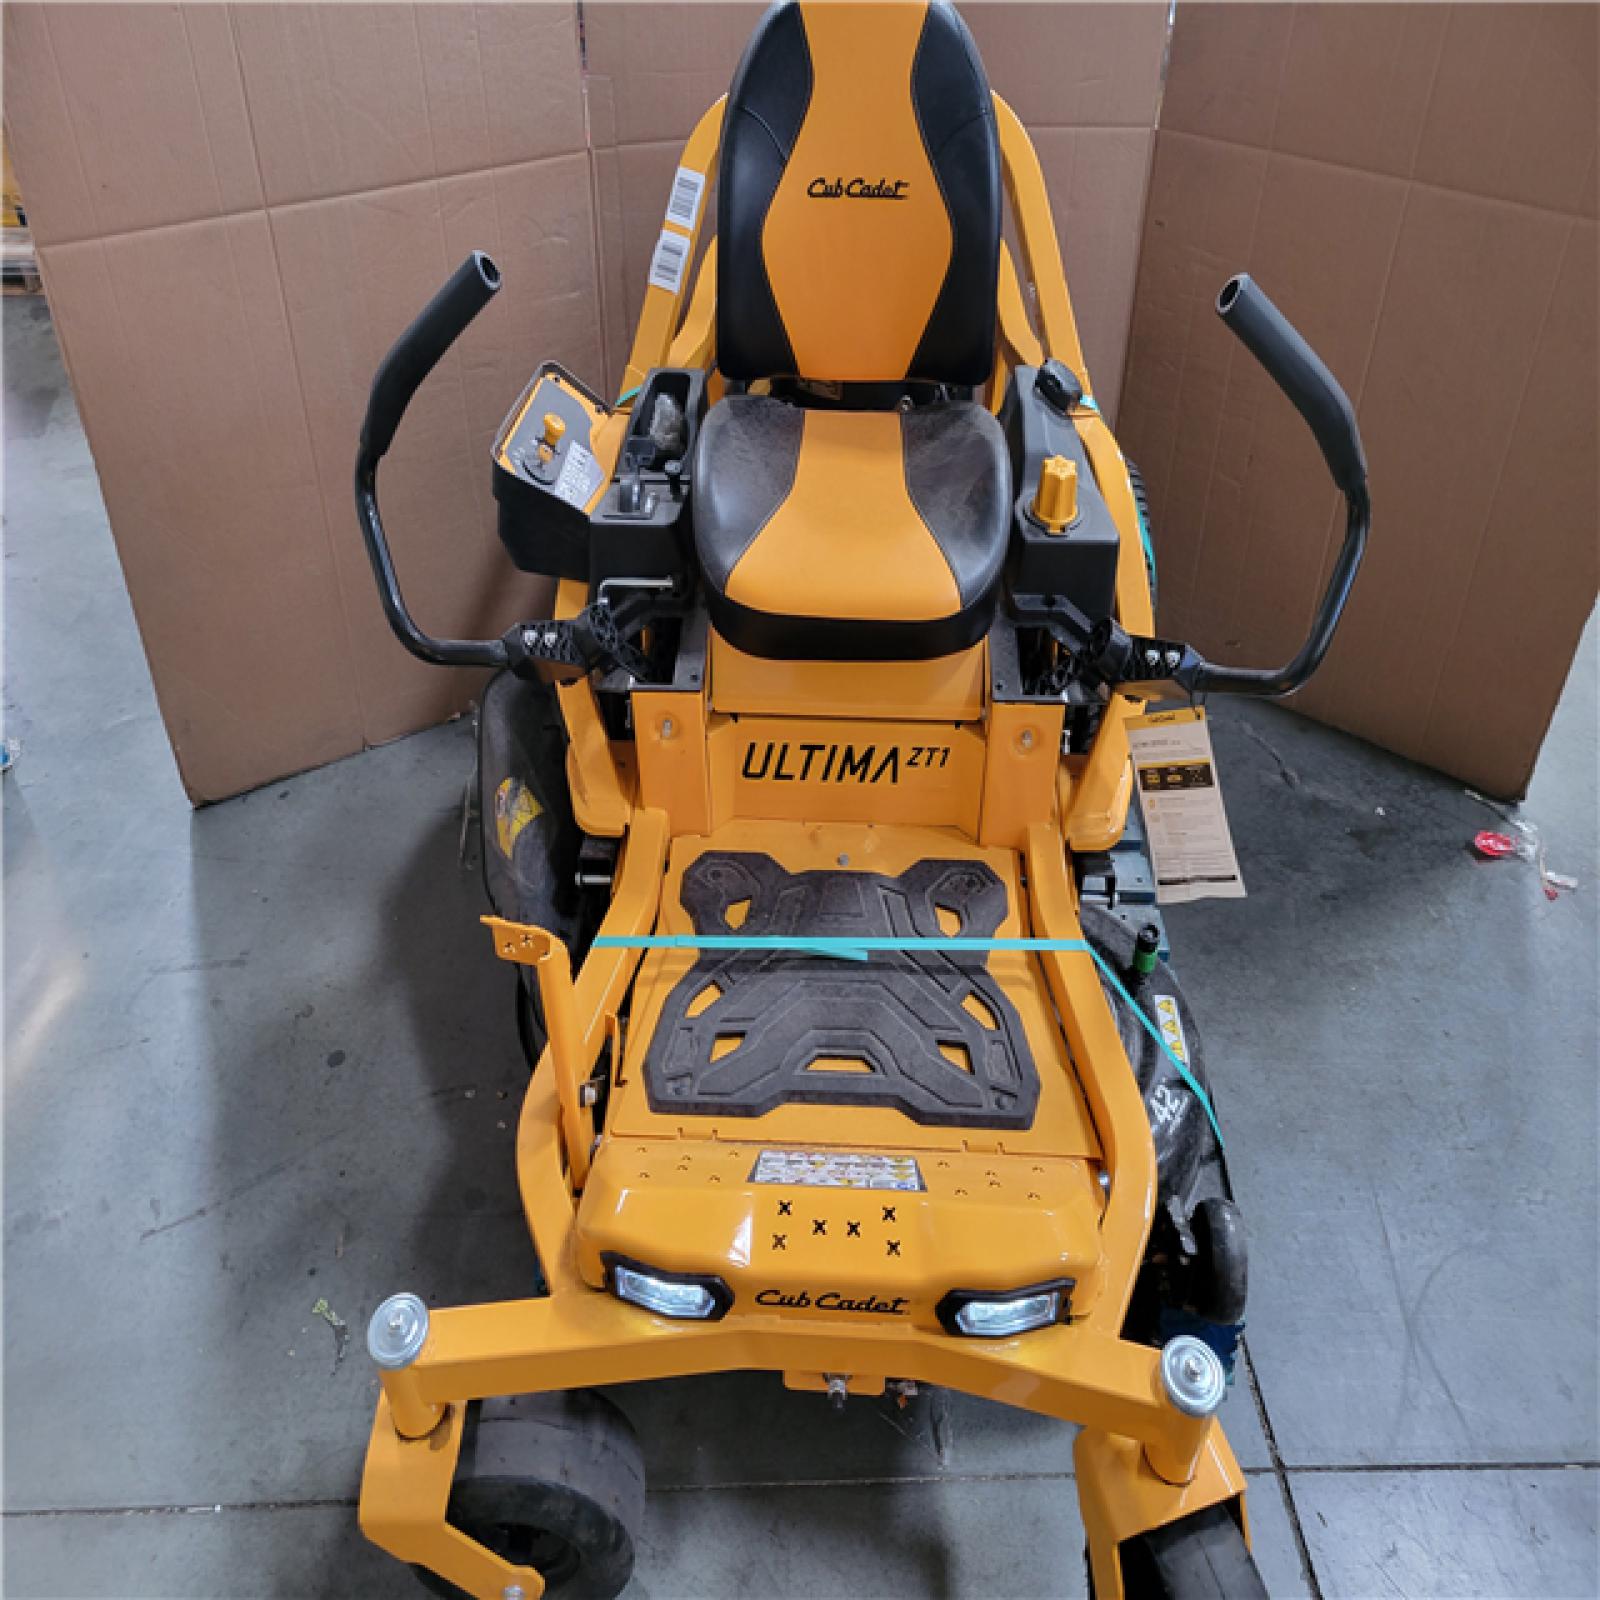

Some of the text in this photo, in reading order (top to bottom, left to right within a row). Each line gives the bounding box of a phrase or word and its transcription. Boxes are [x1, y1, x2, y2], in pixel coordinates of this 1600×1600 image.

[807, 177, 910, 200] Cub Cadet
[742, 742, 950, 784] ULTIMA ZT1
[755, 1289, 911, 1315] Cub Cadet
